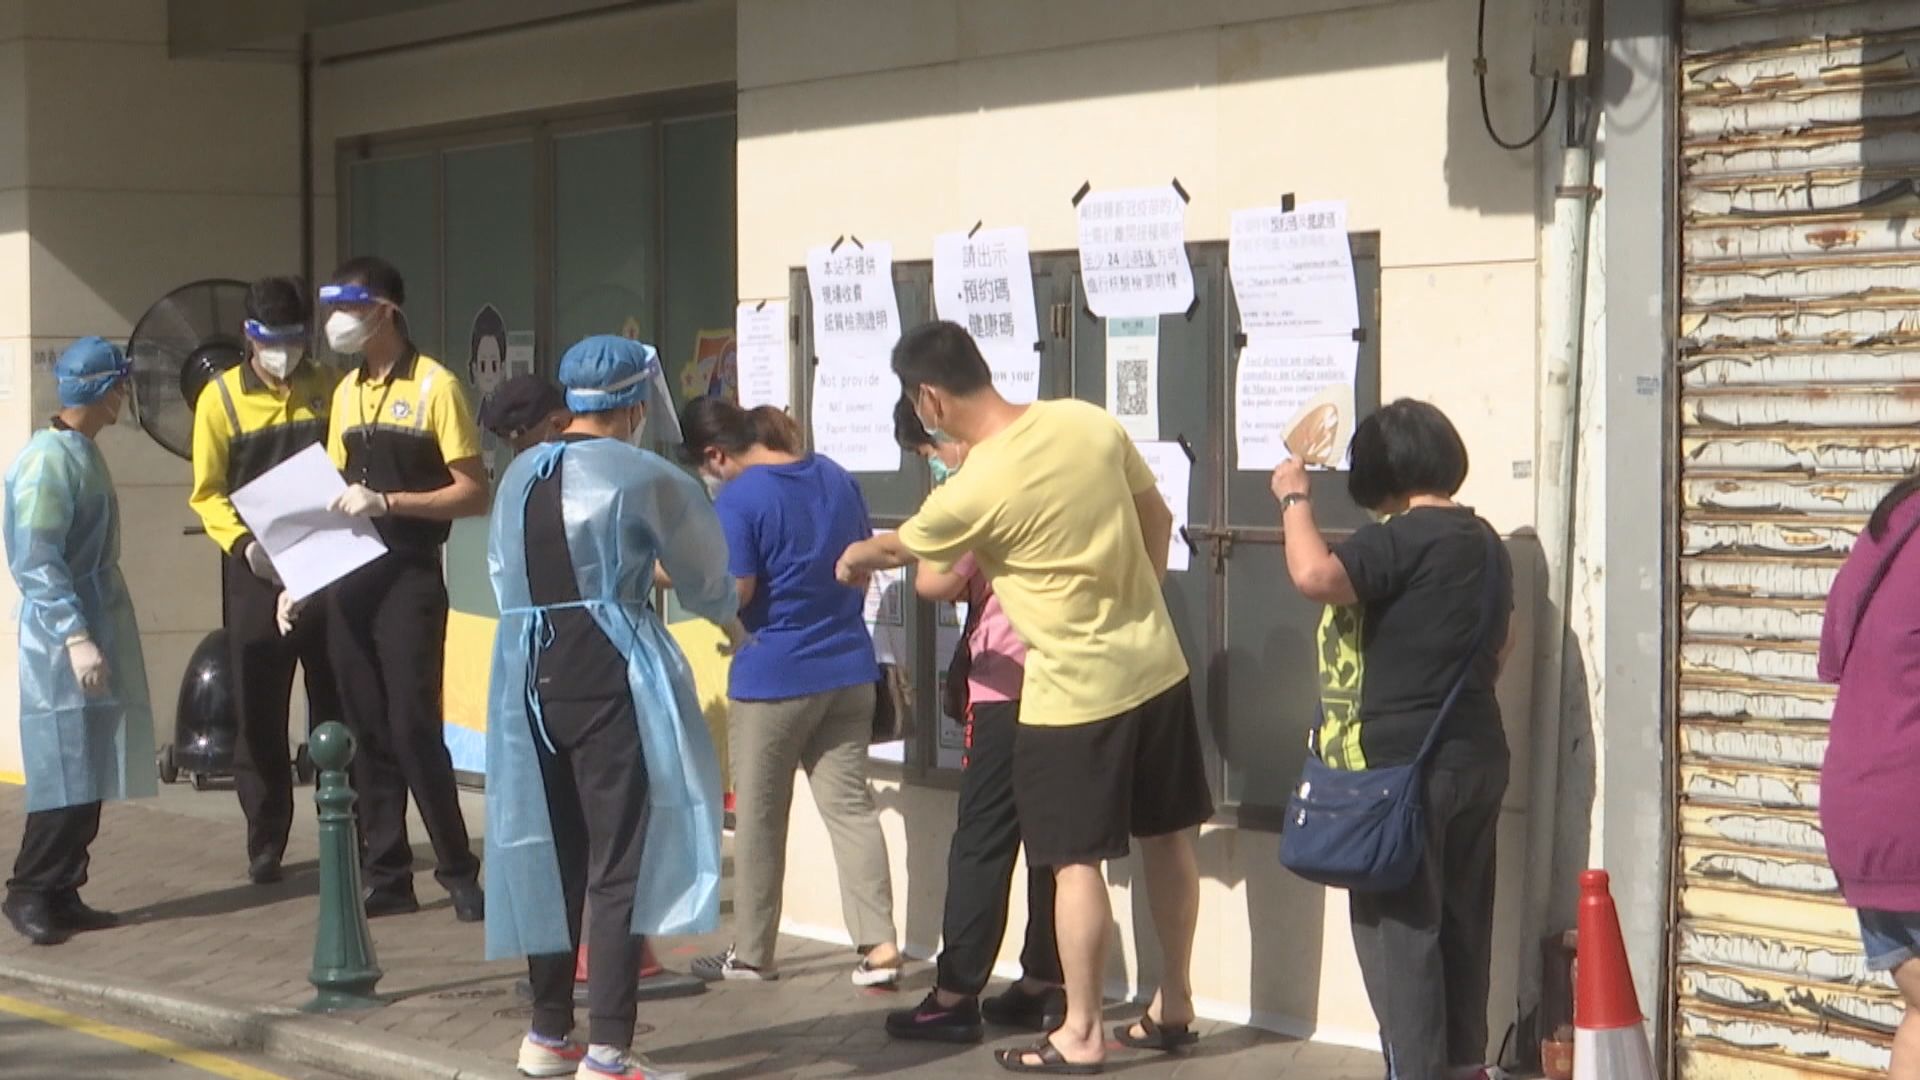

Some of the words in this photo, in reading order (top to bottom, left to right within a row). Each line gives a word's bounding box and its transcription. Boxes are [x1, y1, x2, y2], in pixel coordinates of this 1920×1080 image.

[962, 242, 1008, 269] 請出示
[824, 256, 876, 278] 本站不提供
[822, 284, 862, 305] 現場收費
[963, 278, 1010, 304] 預約碼
[825, 310, 888, 331] 紙質檢測證明
[969, 312, 1014, 339] 健康碼
[821, 374, 837, 387] Not
[841, 373, 879, 389] provide
[1010, 371, 1034, 387] your
